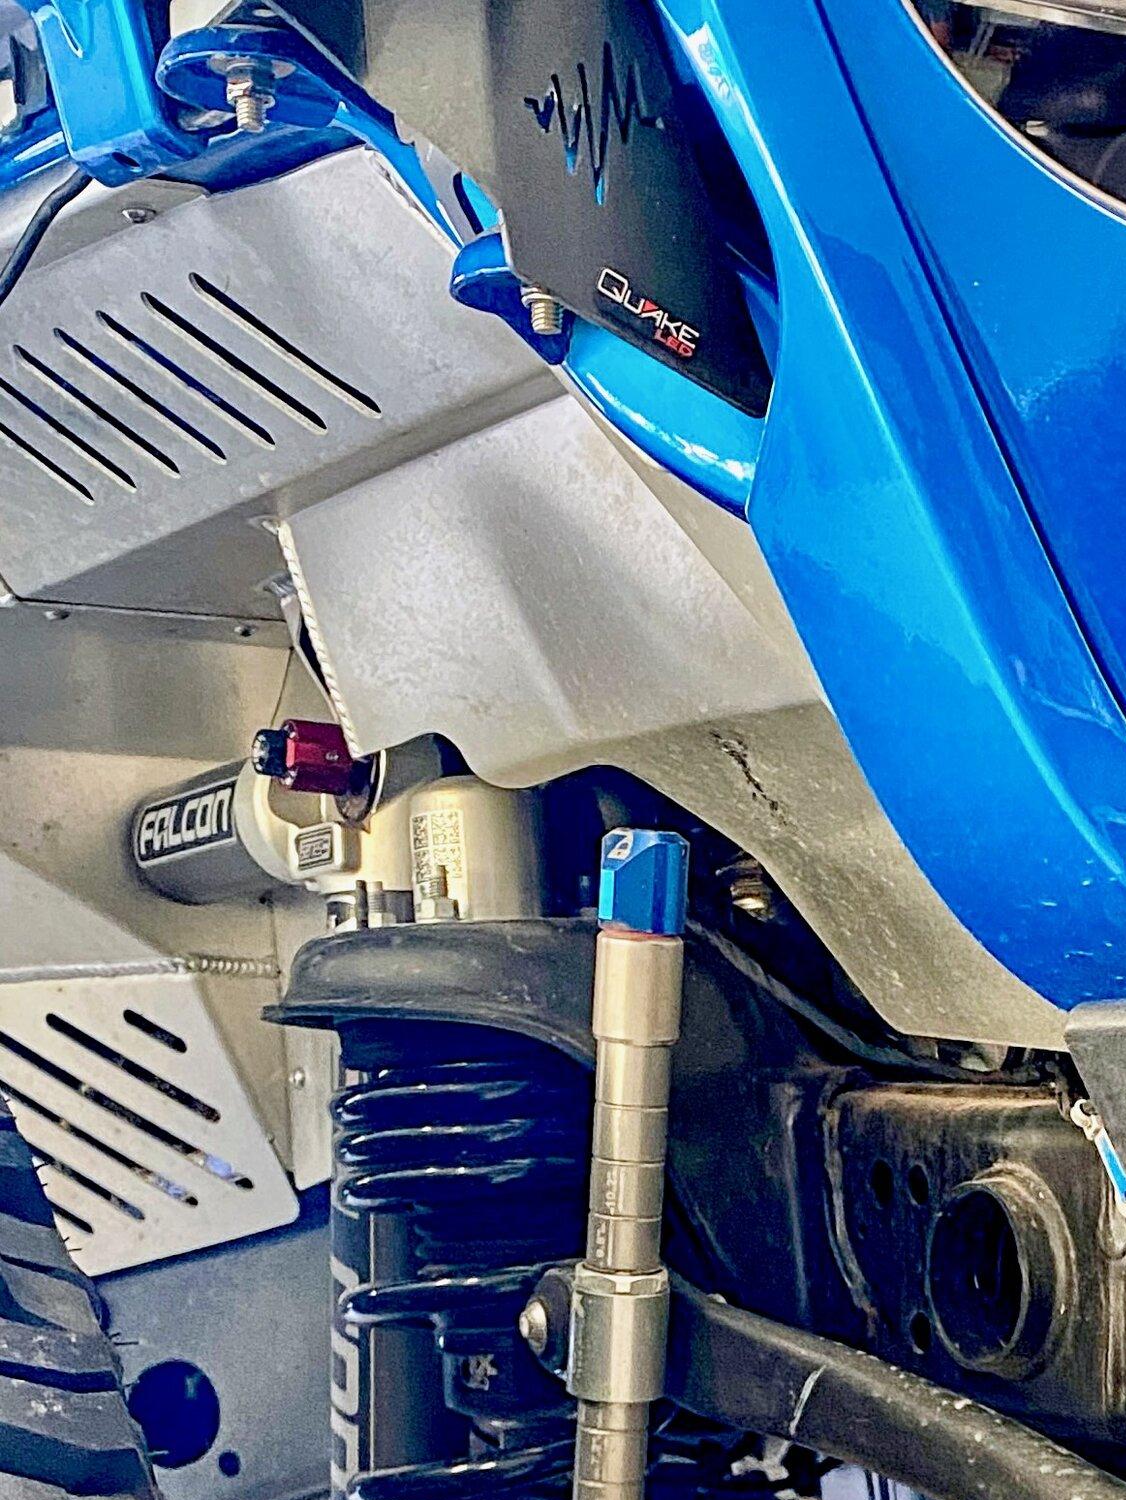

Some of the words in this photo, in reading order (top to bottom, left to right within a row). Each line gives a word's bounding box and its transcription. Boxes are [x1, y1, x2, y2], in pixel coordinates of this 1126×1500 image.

[597, 267, 700, 349] QUAKE
[654, 328, 693, 357] LED
[140, 787, 233, 855] FALCON
